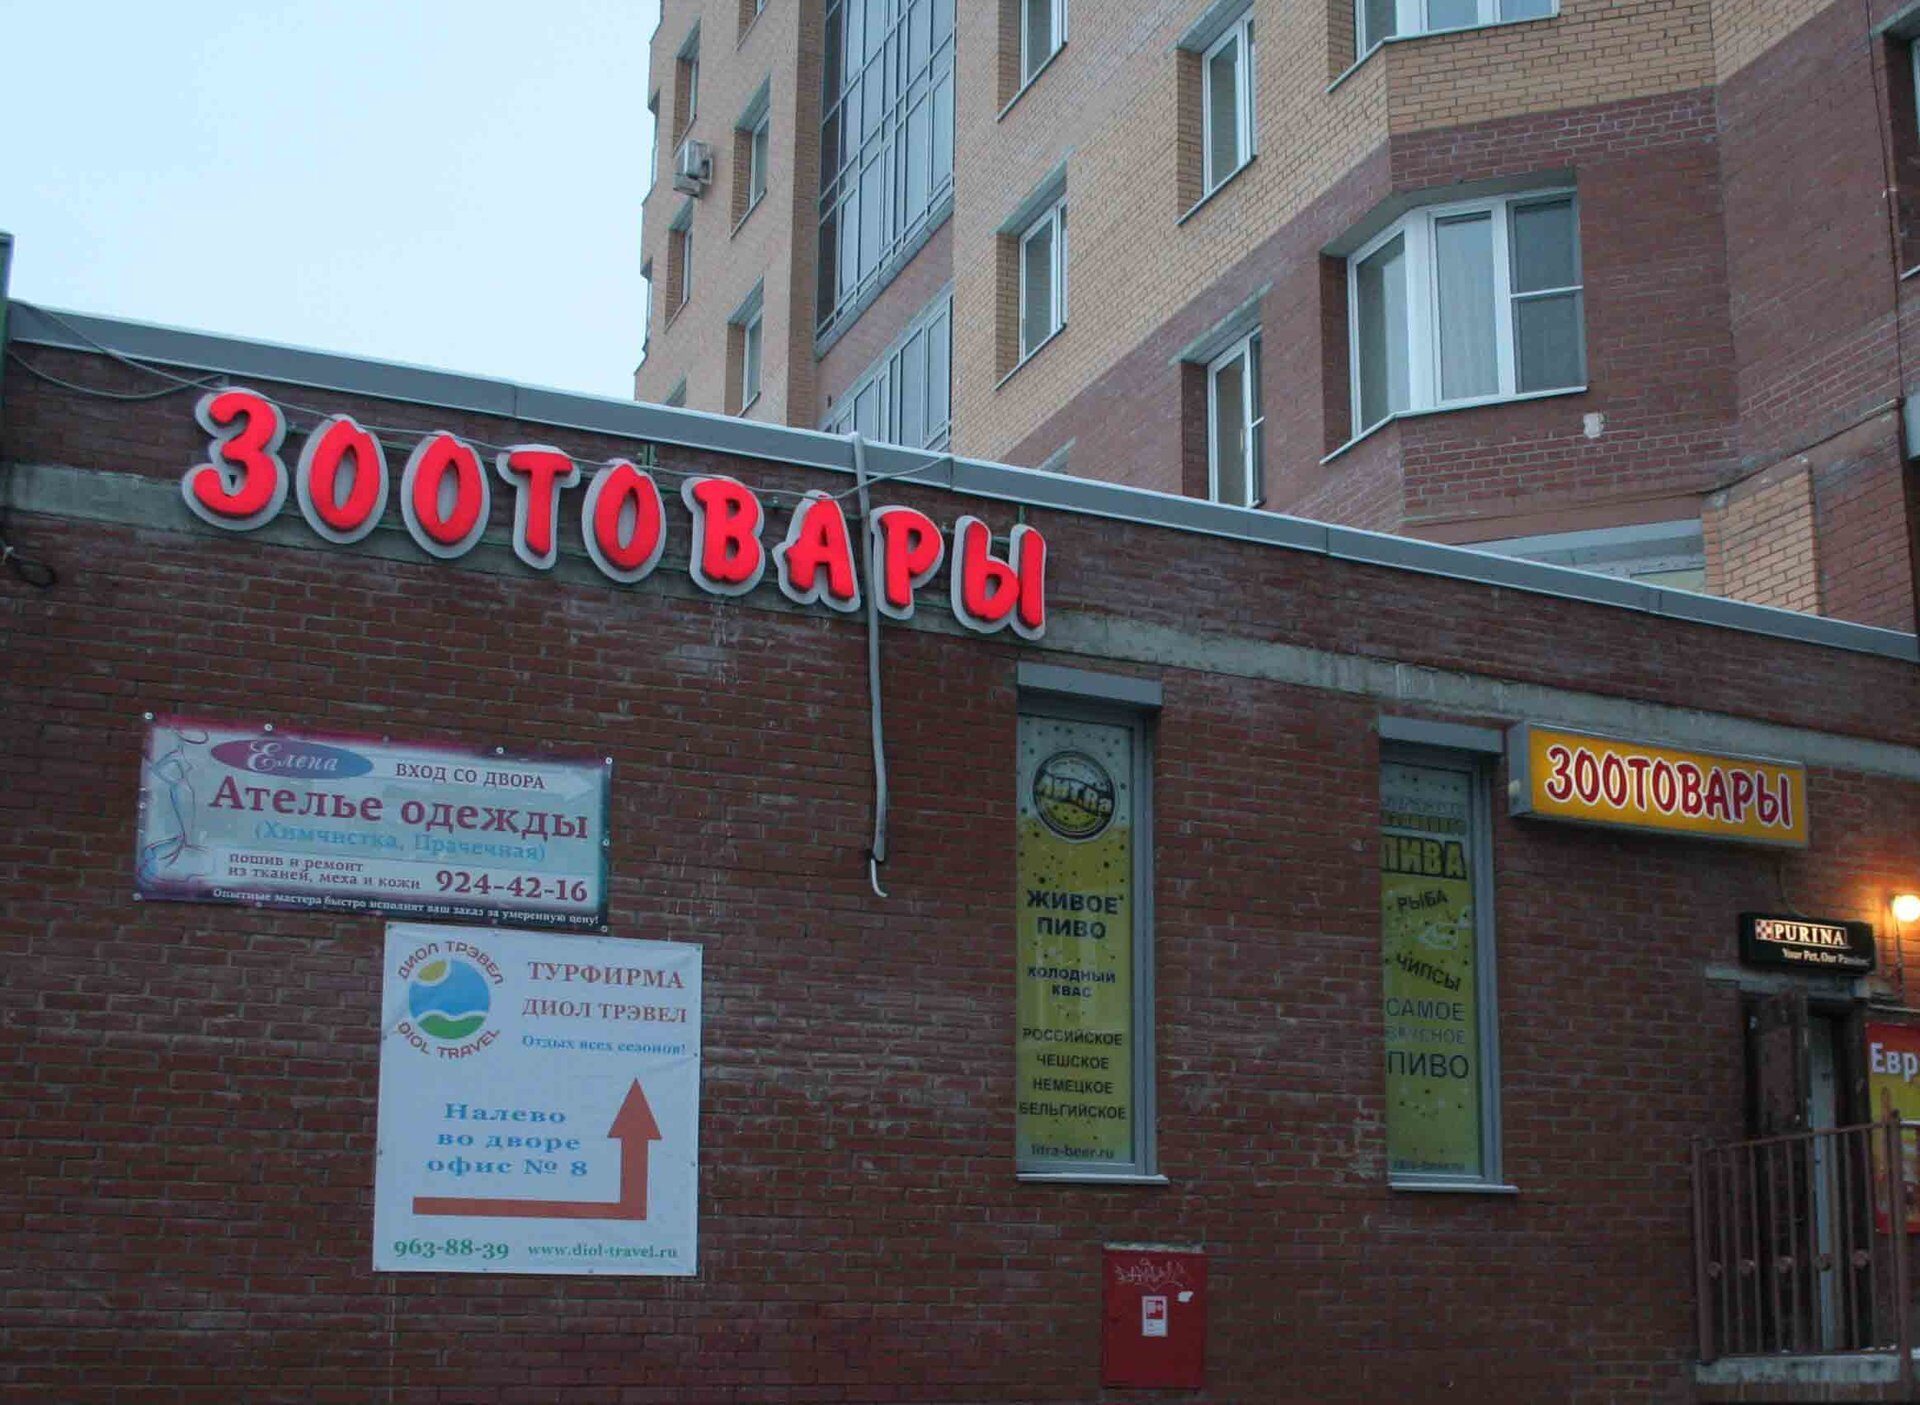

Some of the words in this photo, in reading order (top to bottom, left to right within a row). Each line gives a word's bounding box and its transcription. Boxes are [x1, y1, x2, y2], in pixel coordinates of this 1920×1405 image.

[181, 386, 1048, 642] ЗООТОВАРЫ
[247, 741, 338, 771] Елена
[396, 762, 446, 783] ВХОД
[453, 766, 478, 784] СО
[483, 767, 545, 790] ДВОРА
[1545, 744, 1793, 830] ЗООТОВАРЫ
[209, 775, 383, 821] Ателье
[400, 800, 588, 840] одежды
[415, 833, 546, 863] Прачечная)
[229, 854, 284, 866] пошив
[290, 858, 300, 867] и
[305, 859, 364, 872] ремонт
[229, 867, 247, 876] из
[252, 868, 313, 883] тканей,
[320, 873, 357, 885] меха
[364, 877, 372, 886] и
[379, 879, 421, 890] кожи
[436, 869, 588, 902] 924-42-16
[213, 888, 271, 901] Опытные
[275, 894, 322, 906] мастера
[324, 894, 367, 909] быстро
[427, 904, 450, 914] ваш
[503, 909, 566, 923] умеренную
[1026, 889, 1118, 914] ЖИВОЕ
[1398, 889, 1448, 912] РЫБА
[1037, 917, 1107, 939] ПИВО
[1774, 923, 1845, 947] PURINA
[398, 943, 439, 979] ДИОЛ
[445, 941, 504, 985] ТРЭВЕЛ
[1397, 952, 1461, 992] ЧИПСЫ
[528, 961, 684, 989] ТУРФИРМА
[1027, 966, 1116, 984] КОЛОДНЫЙ
[1052, 984, 1092, 998] КВАС
[522, 998, 591, 1019] ДИОЛ
[598, 1002, 688, 1024] ТРЭВЕЛ
[1386, 998, 1466, 1021] САМОЕ
[398, 1022, 429, 1054] DIOL
[437, 1030, 500, 1059] TRAVEL
[522, 1034, 574, 1051] Отдых
[579, 1039, 613, 1052] всех
[618, 1042, 686, 1056] сезонов!
[1022, 1027, 1123, 1046] РОССИЙСКОЕ
[1037, 1054, 1109, 1069] ЧЕШСКОЕ
[1387, 1051, 1469, 1079] ПИВО
[1033, 1078, 1113, 1094] НЕМЕЦКОЕ
[444, 1103, 566, 1124] Налево
[1019, 1101, 1127, 1120] БЕЛЬГИЙСКОЕ
[437, 1133, 474, 1147] во
[485, 1136, 581, 1154] дворе
[427, 1156, 512, 1177] офис
[523, 1158, 557, 1175] №
[570, 1160, 588, 1177] 8
[394, 1239, 509, 1259] 963-88-39
[528, 1243, 679, 1260] www.diol-travel.ru
